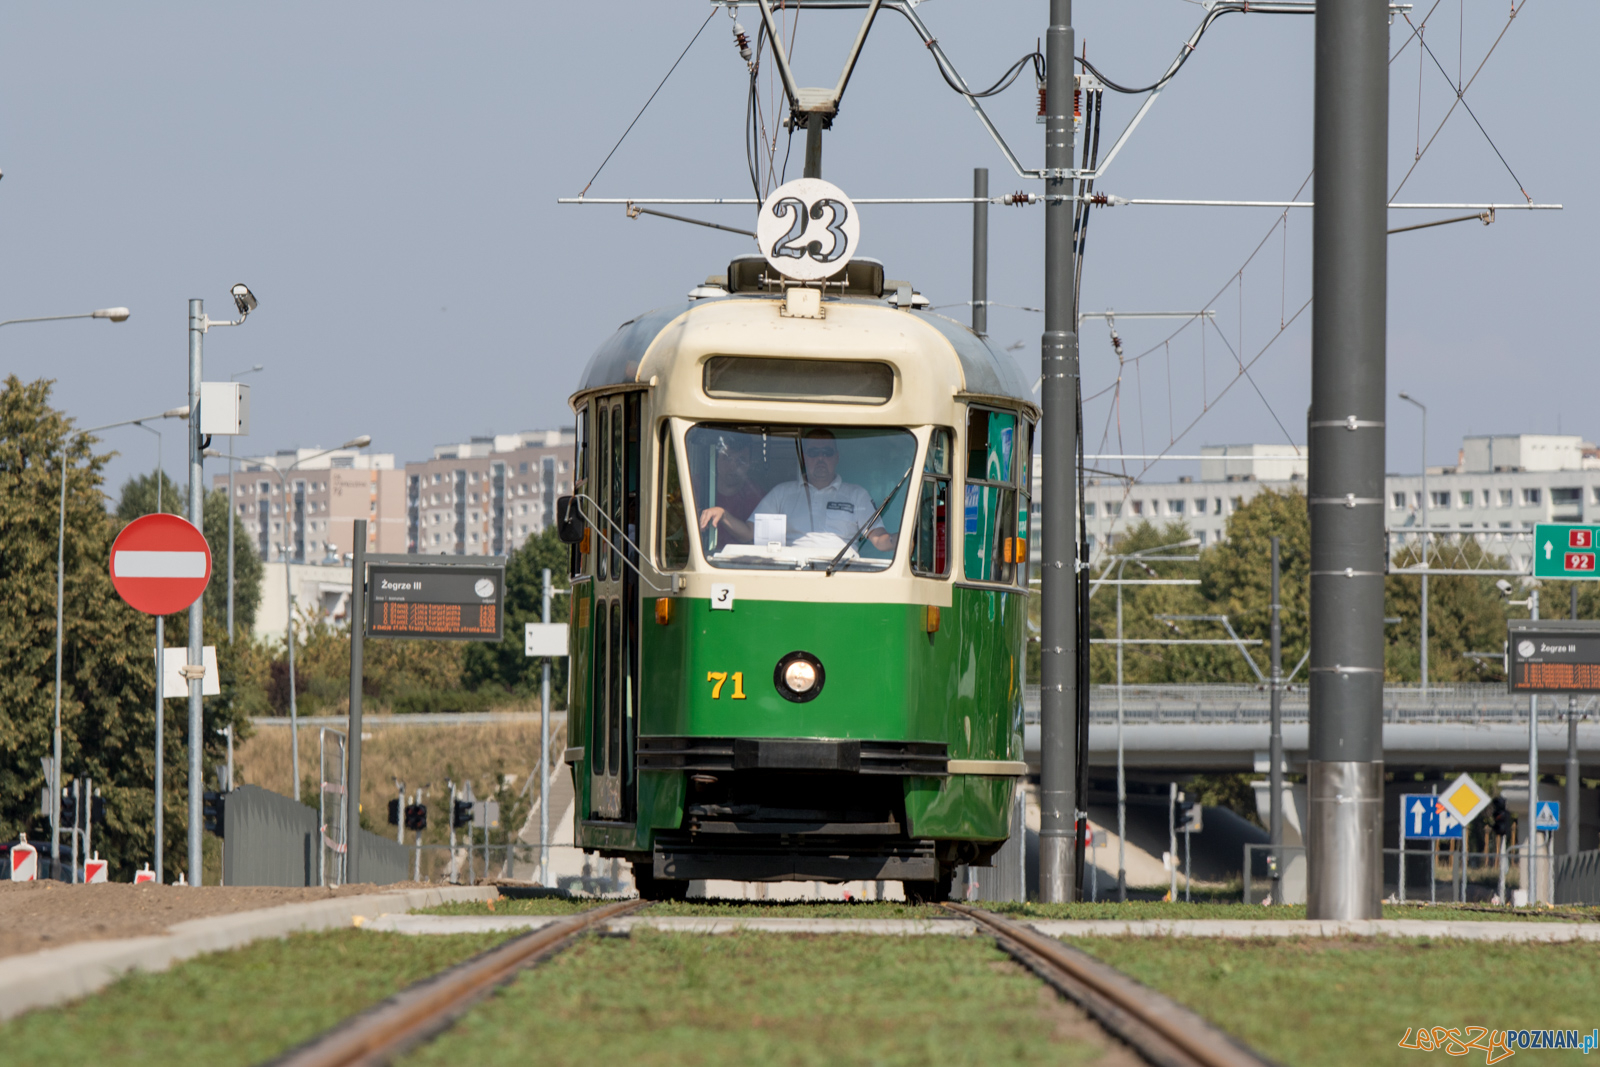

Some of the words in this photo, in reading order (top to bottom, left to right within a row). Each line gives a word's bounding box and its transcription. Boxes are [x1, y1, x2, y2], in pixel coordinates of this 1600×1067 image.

[771, 196, 849, 263] 23
[1576, 532, 1585, 546] 5
[1571, 555, 1588, 568] 92
[381, 579, 411, 591] Żegrze
[717, 589, 729, 602] 3
[707, 671, 746, 699] 71
